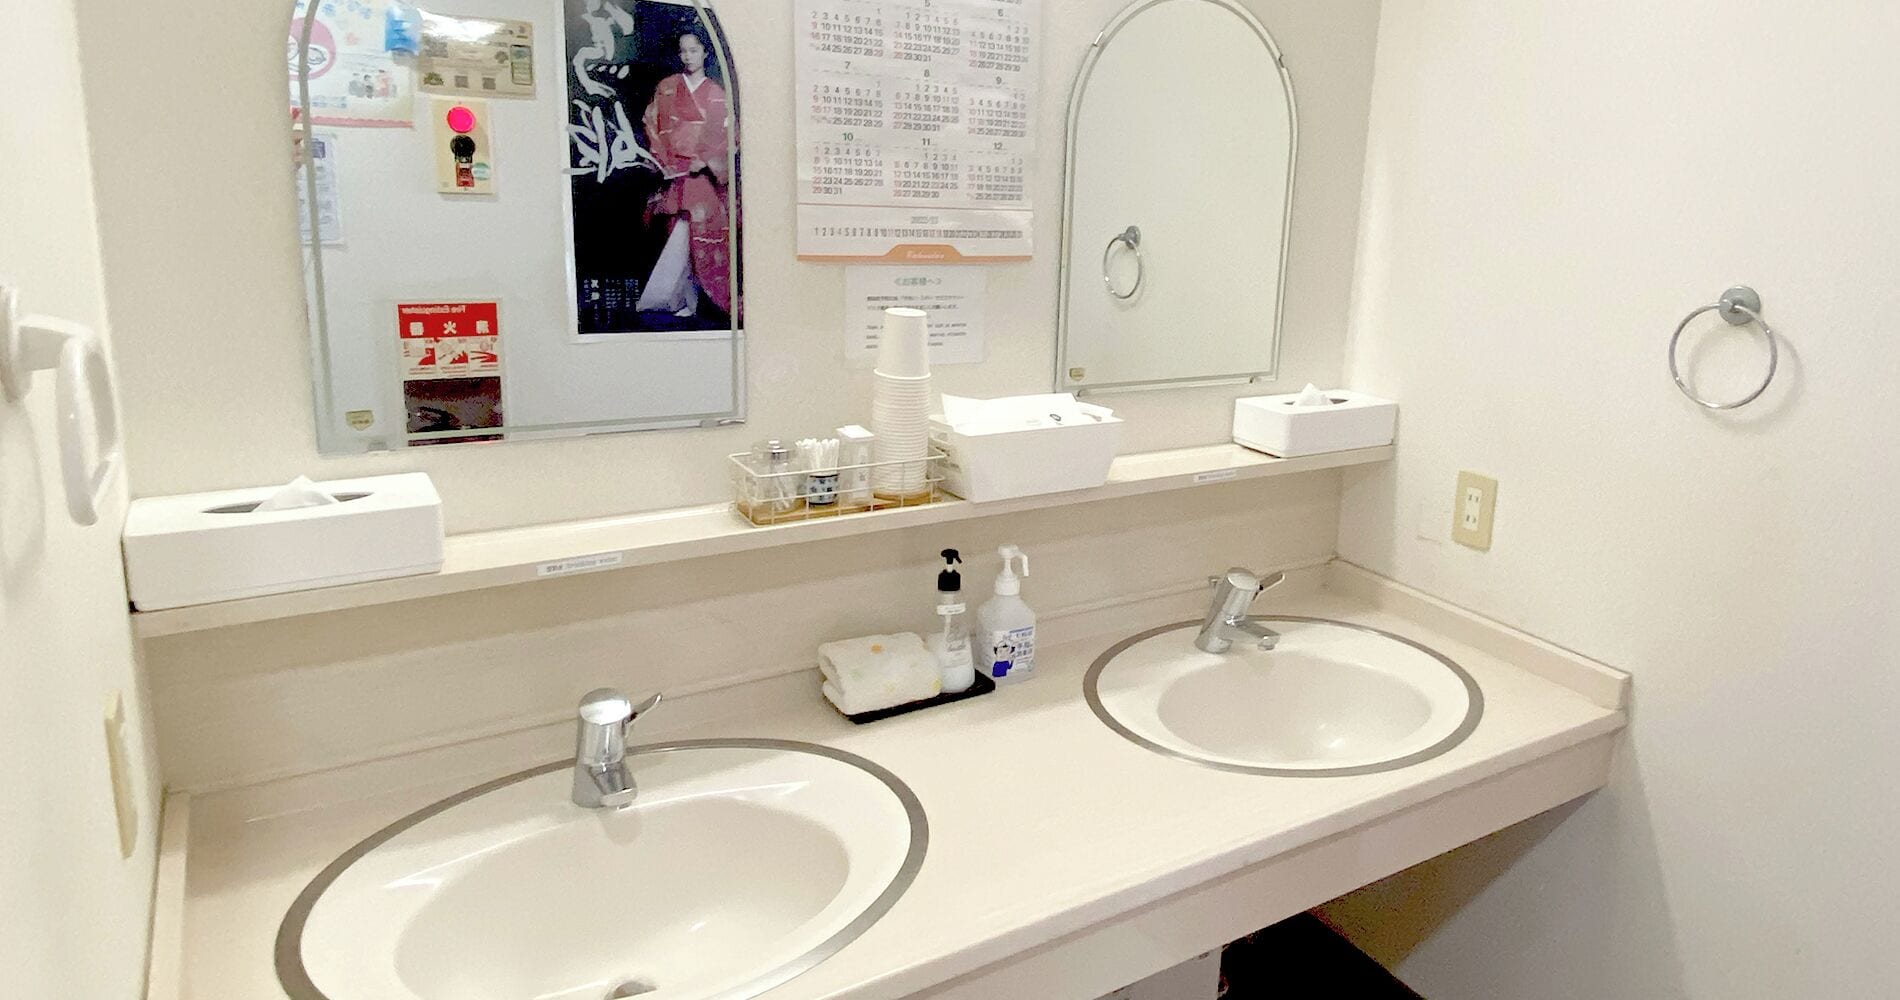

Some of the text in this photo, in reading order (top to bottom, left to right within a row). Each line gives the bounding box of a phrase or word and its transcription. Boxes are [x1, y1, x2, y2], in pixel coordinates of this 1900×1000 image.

[811, 10, 818, 19] 2
[823, 12, 828, 20] 3
[998, 9, 1003, 17] 6
[843, 25, 852, 33] 12
[854, 36, 863, 44] 20
[863, 37, 872, 45] 21
[845, 61, 851, 69] 7
[924, 69, 930, 77] 8
[996, 76, 1002, 84] 9
[824, 85, 829, 93] 3
[844, 97, 852, 106] 12
[854, 108, 863, 116] 20
[843, 132, 853, 141] 10
[922, 138, 930, 146] 11
[994, 142, 1003, 150] 12
[835, 147, 840, 155] 3
[854, 158, 862, 166] 12
[933, 162, 938, 170] 9
[855, 168, 863, 176] 19
[822, 227, 826, 236] 2
